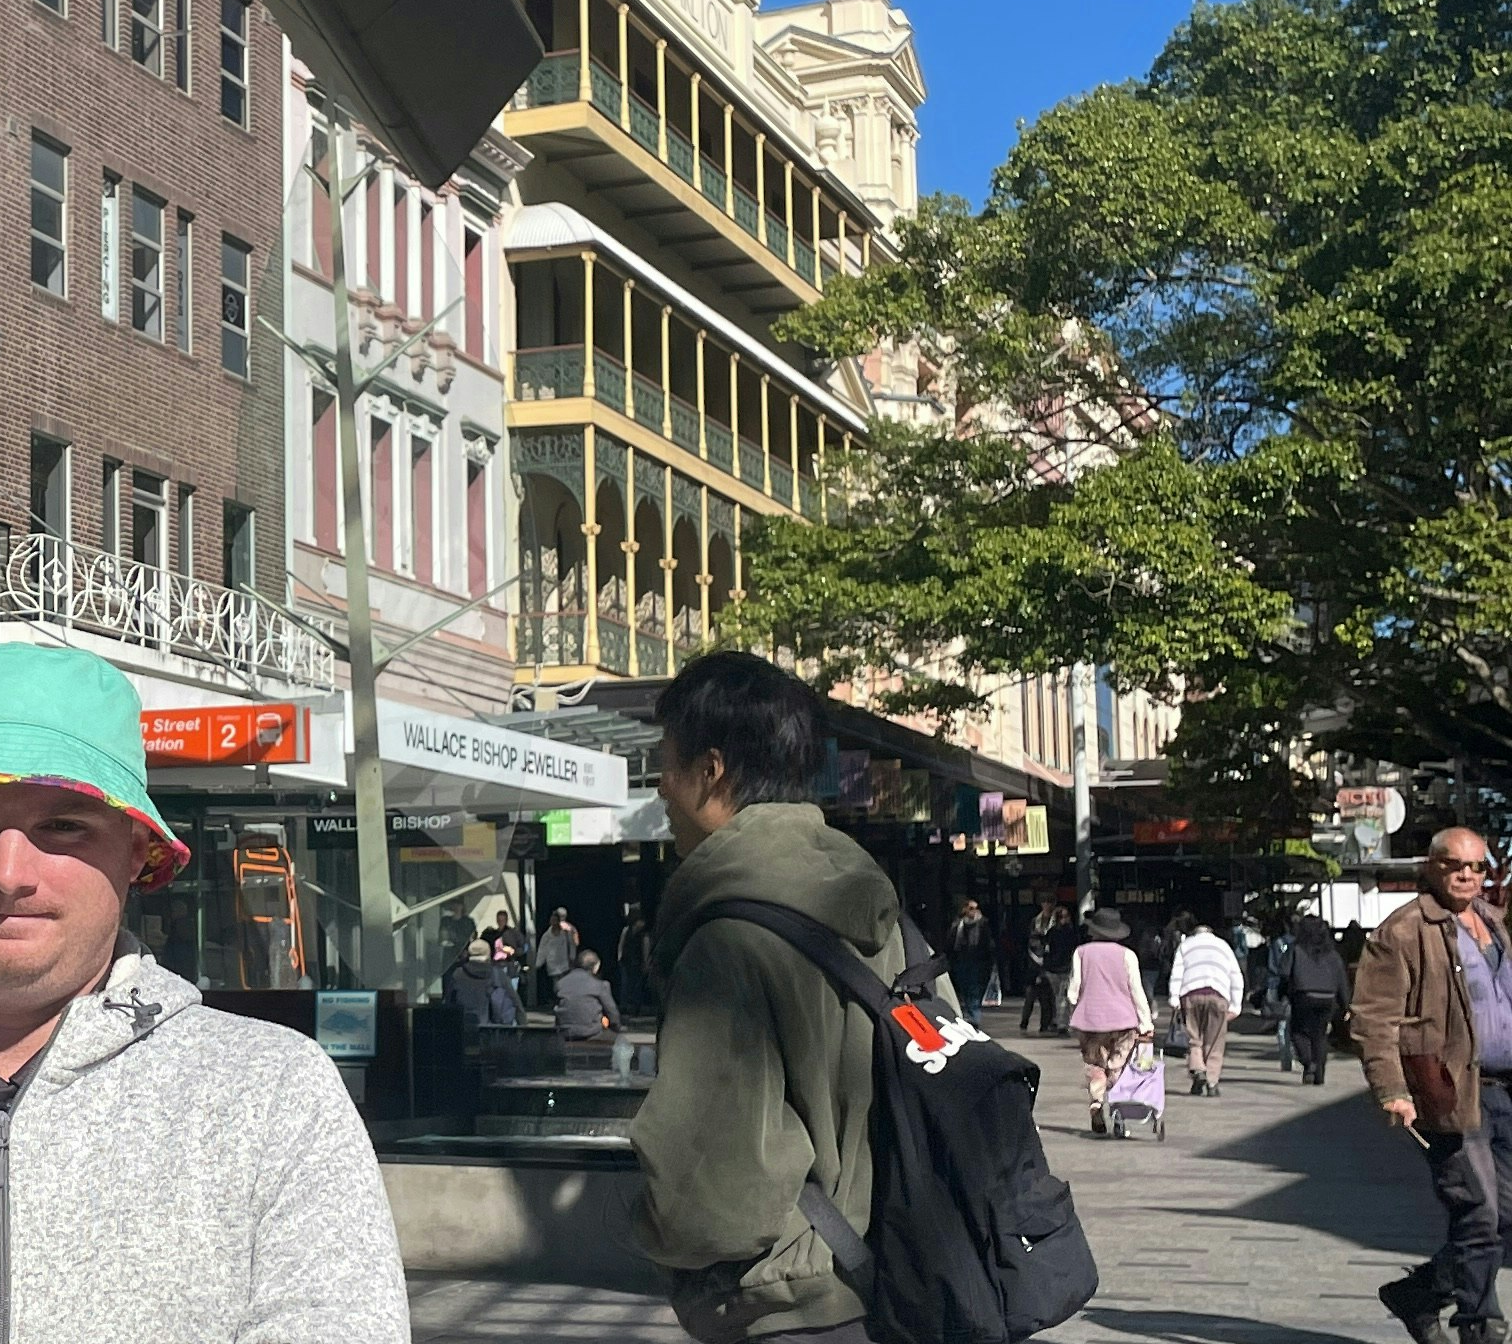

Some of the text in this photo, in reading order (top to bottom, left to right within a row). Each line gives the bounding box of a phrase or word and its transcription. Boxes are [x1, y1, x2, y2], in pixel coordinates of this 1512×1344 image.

[153, 717, 201, 733] Street
[220, 723, 237, 748] 2
[403, 721, 578, 784] WALLACE BISHOP JEWELLER
[313, 815, 451, 833] WALL BISHOP
